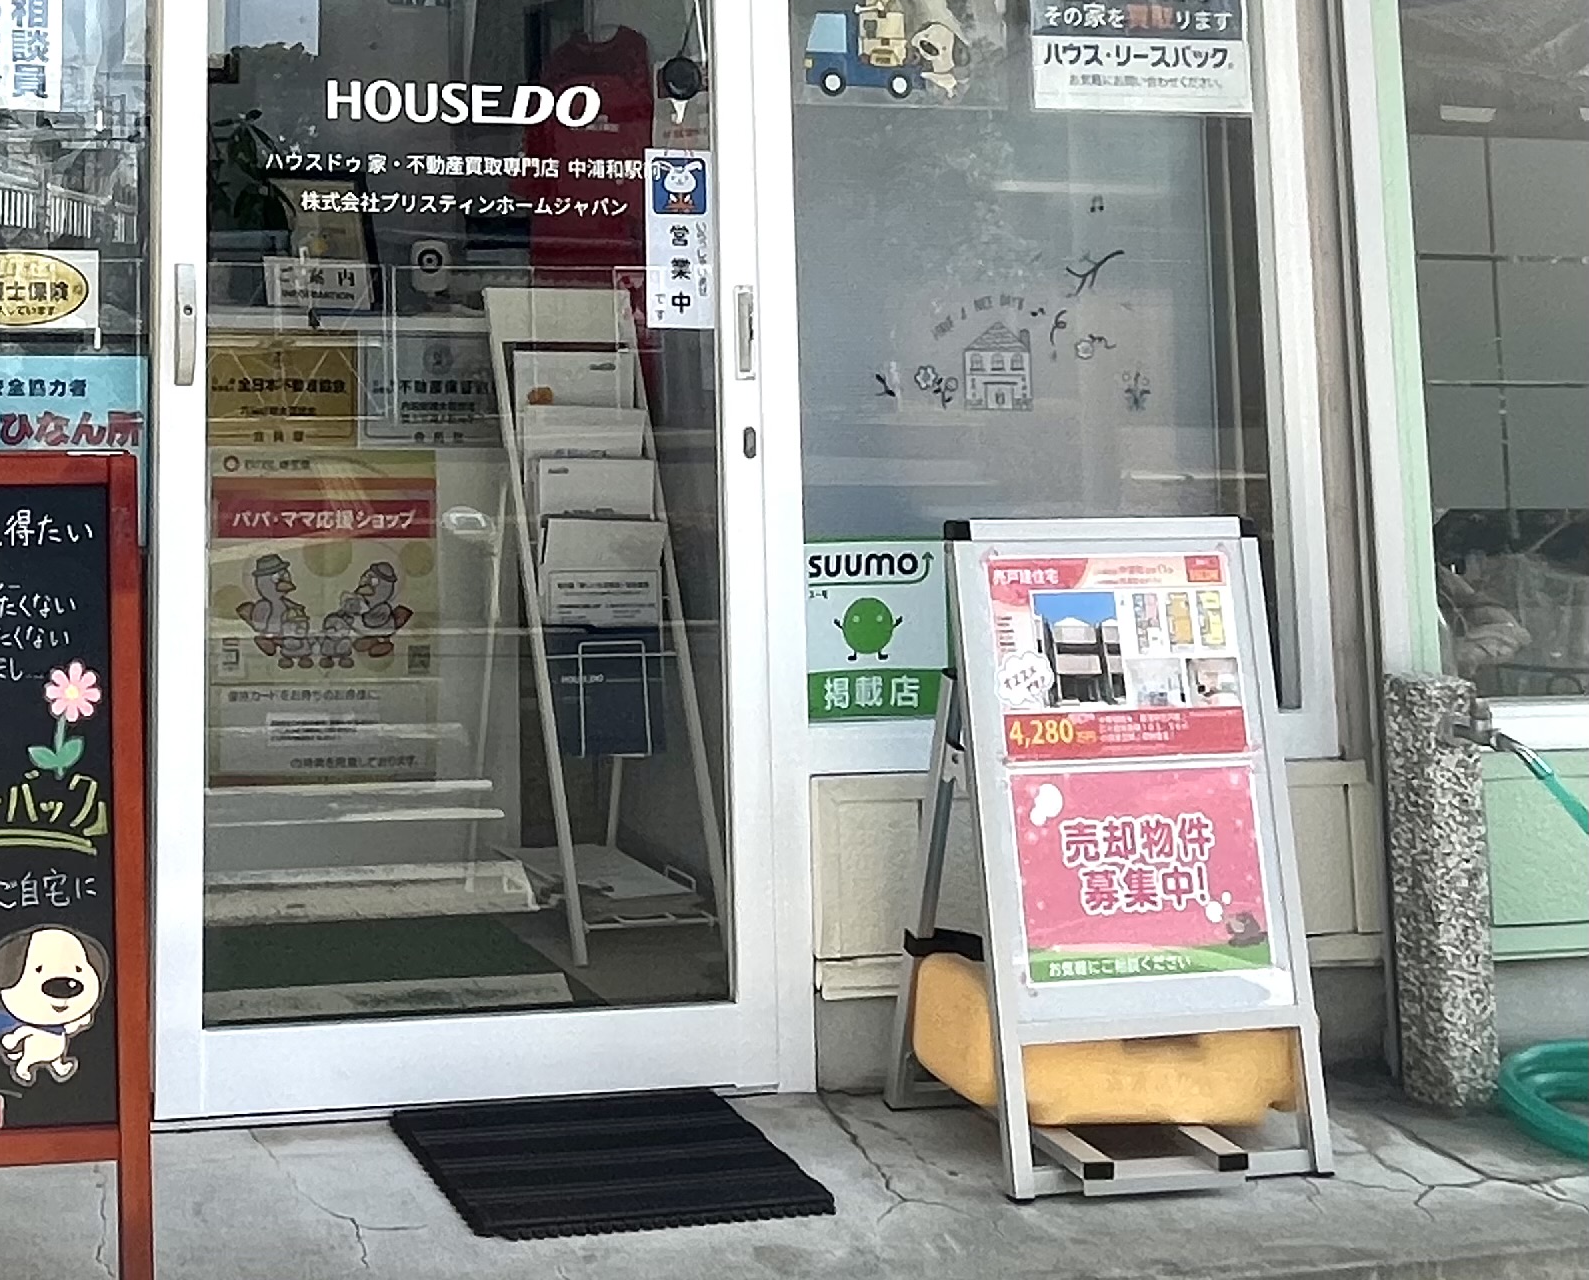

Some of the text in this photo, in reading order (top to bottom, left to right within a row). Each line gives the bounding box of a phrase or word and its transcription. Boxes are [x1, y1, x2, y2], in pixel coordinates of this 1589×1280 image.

[1044, 3, 1233, 32] その家を買取ります
[265, 153, 361, 174] ハウスドゥ
[301, 189, 629, 217] 株式会社プリスティンホームジャパン
[669, 224, 691, 314] 営業中
[232, 509, 416, 530] パパ・ママ応援ショップ
[823, 675, 921, 709] 掲載店
[1062, 814, 1215, 866] 売却物件
[1081, 863, 1208, 914] 募集中!
